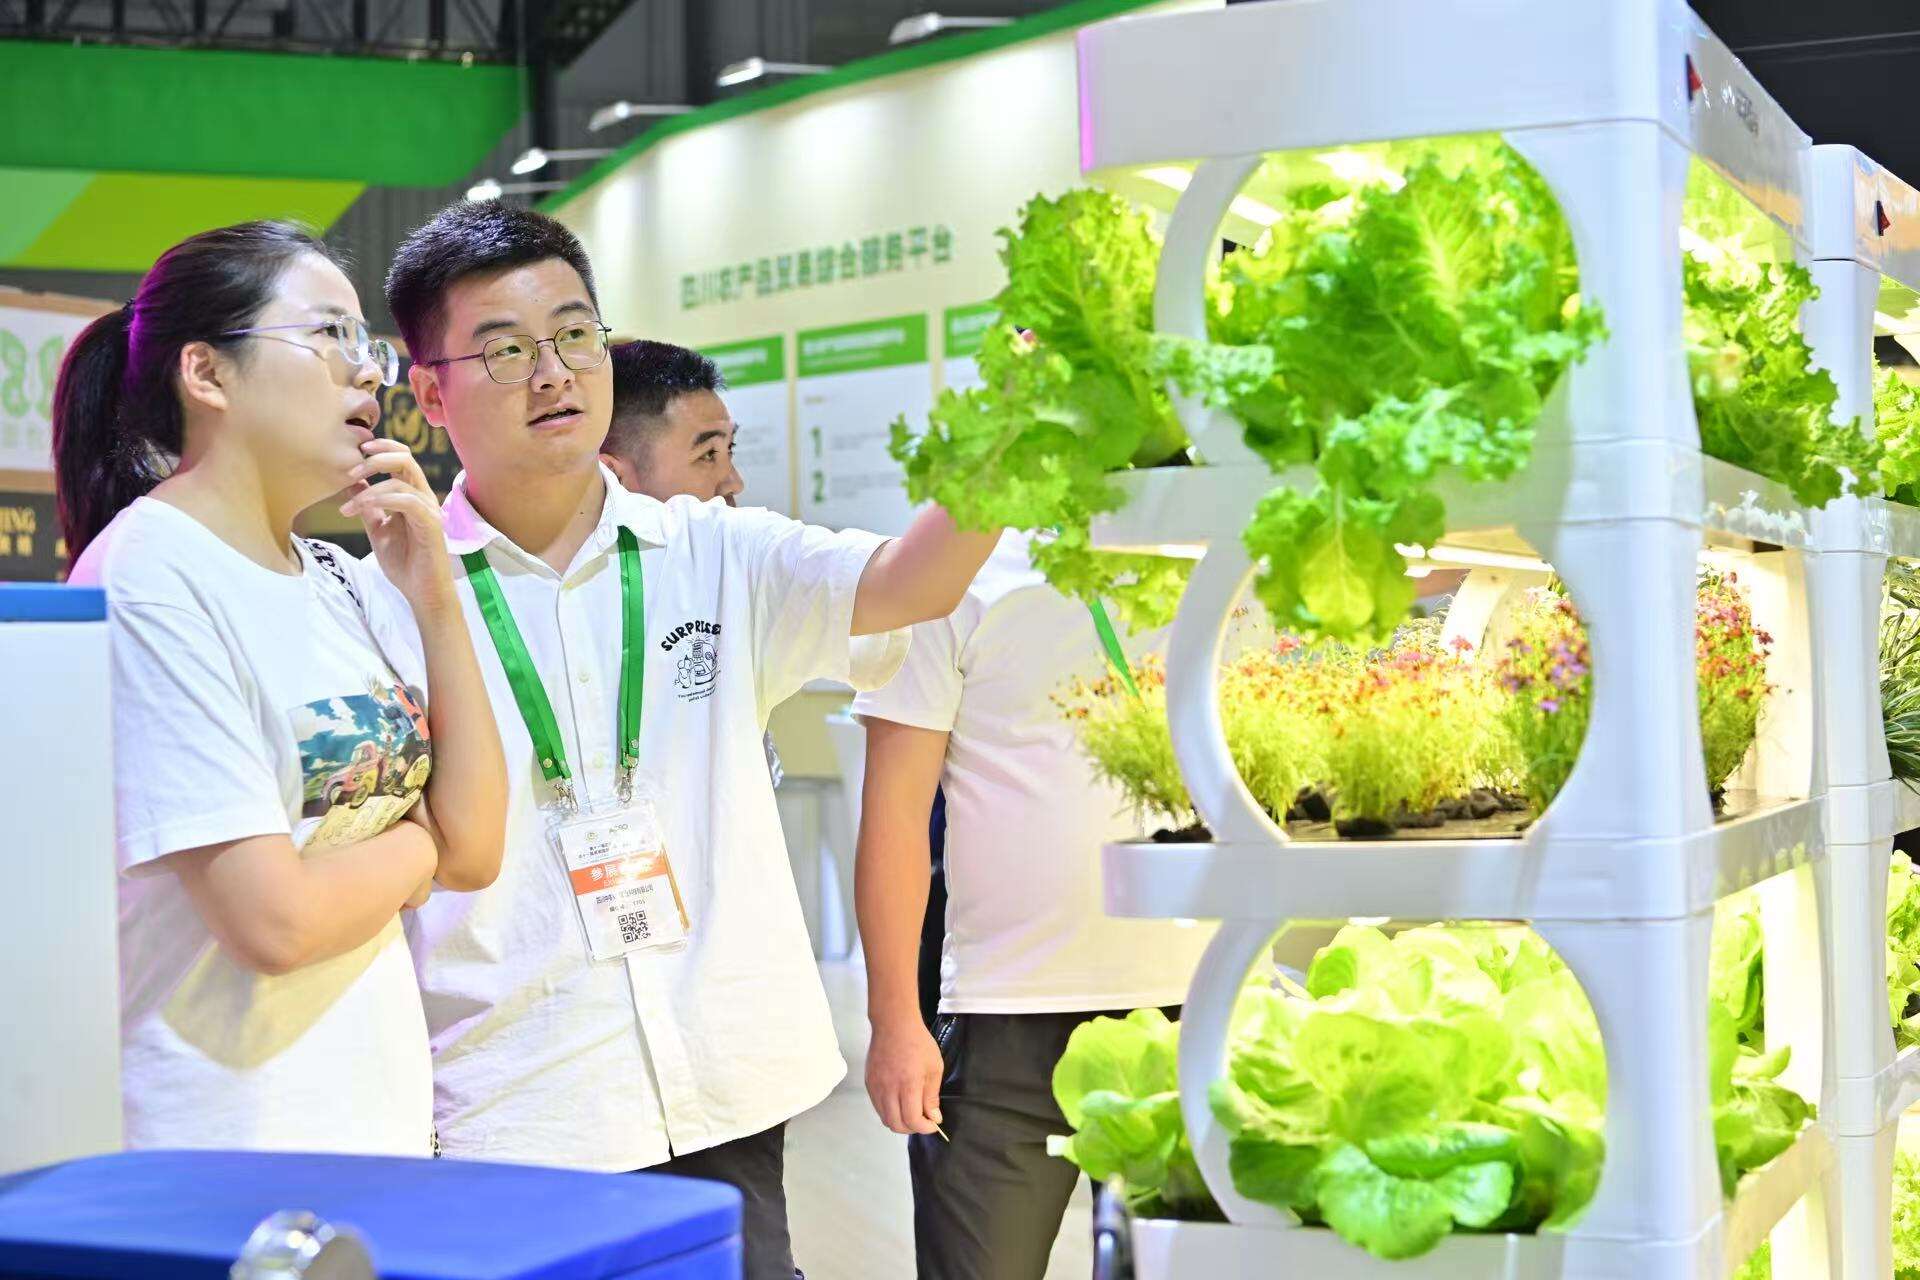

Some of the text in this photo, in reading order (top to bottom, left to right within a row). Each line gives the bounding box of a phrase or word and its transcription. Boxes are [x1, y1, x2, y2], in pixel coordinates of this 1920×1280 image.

[810, 426, 821, 457] 1
[811, 470, 824, 503] 2
[661, 620, 722, 651] SURPRISE
